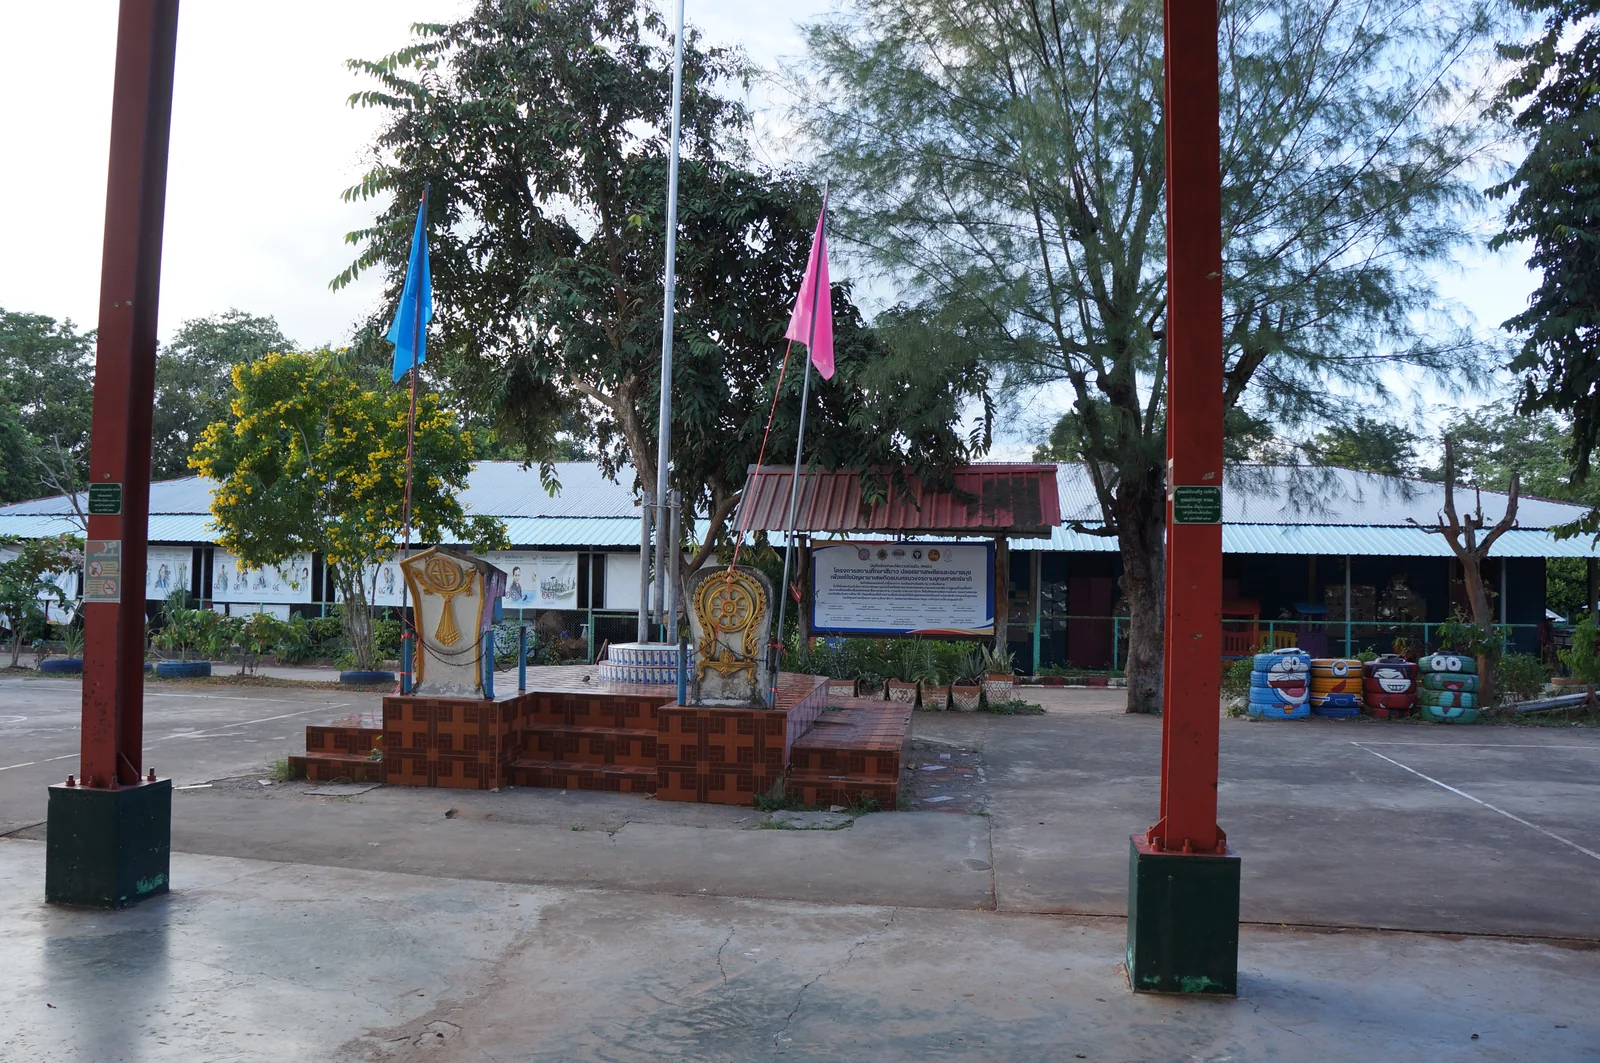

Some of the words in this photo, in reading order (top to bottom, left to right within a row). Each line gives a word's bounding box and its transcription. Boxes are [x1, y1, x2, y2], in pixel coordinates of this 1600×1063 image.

[830, 574, 972, 582] เพื่อแก้ไขปัญหายาเสพติดแบบครบวงจรตามยุทธศาสตร์ชาติ
